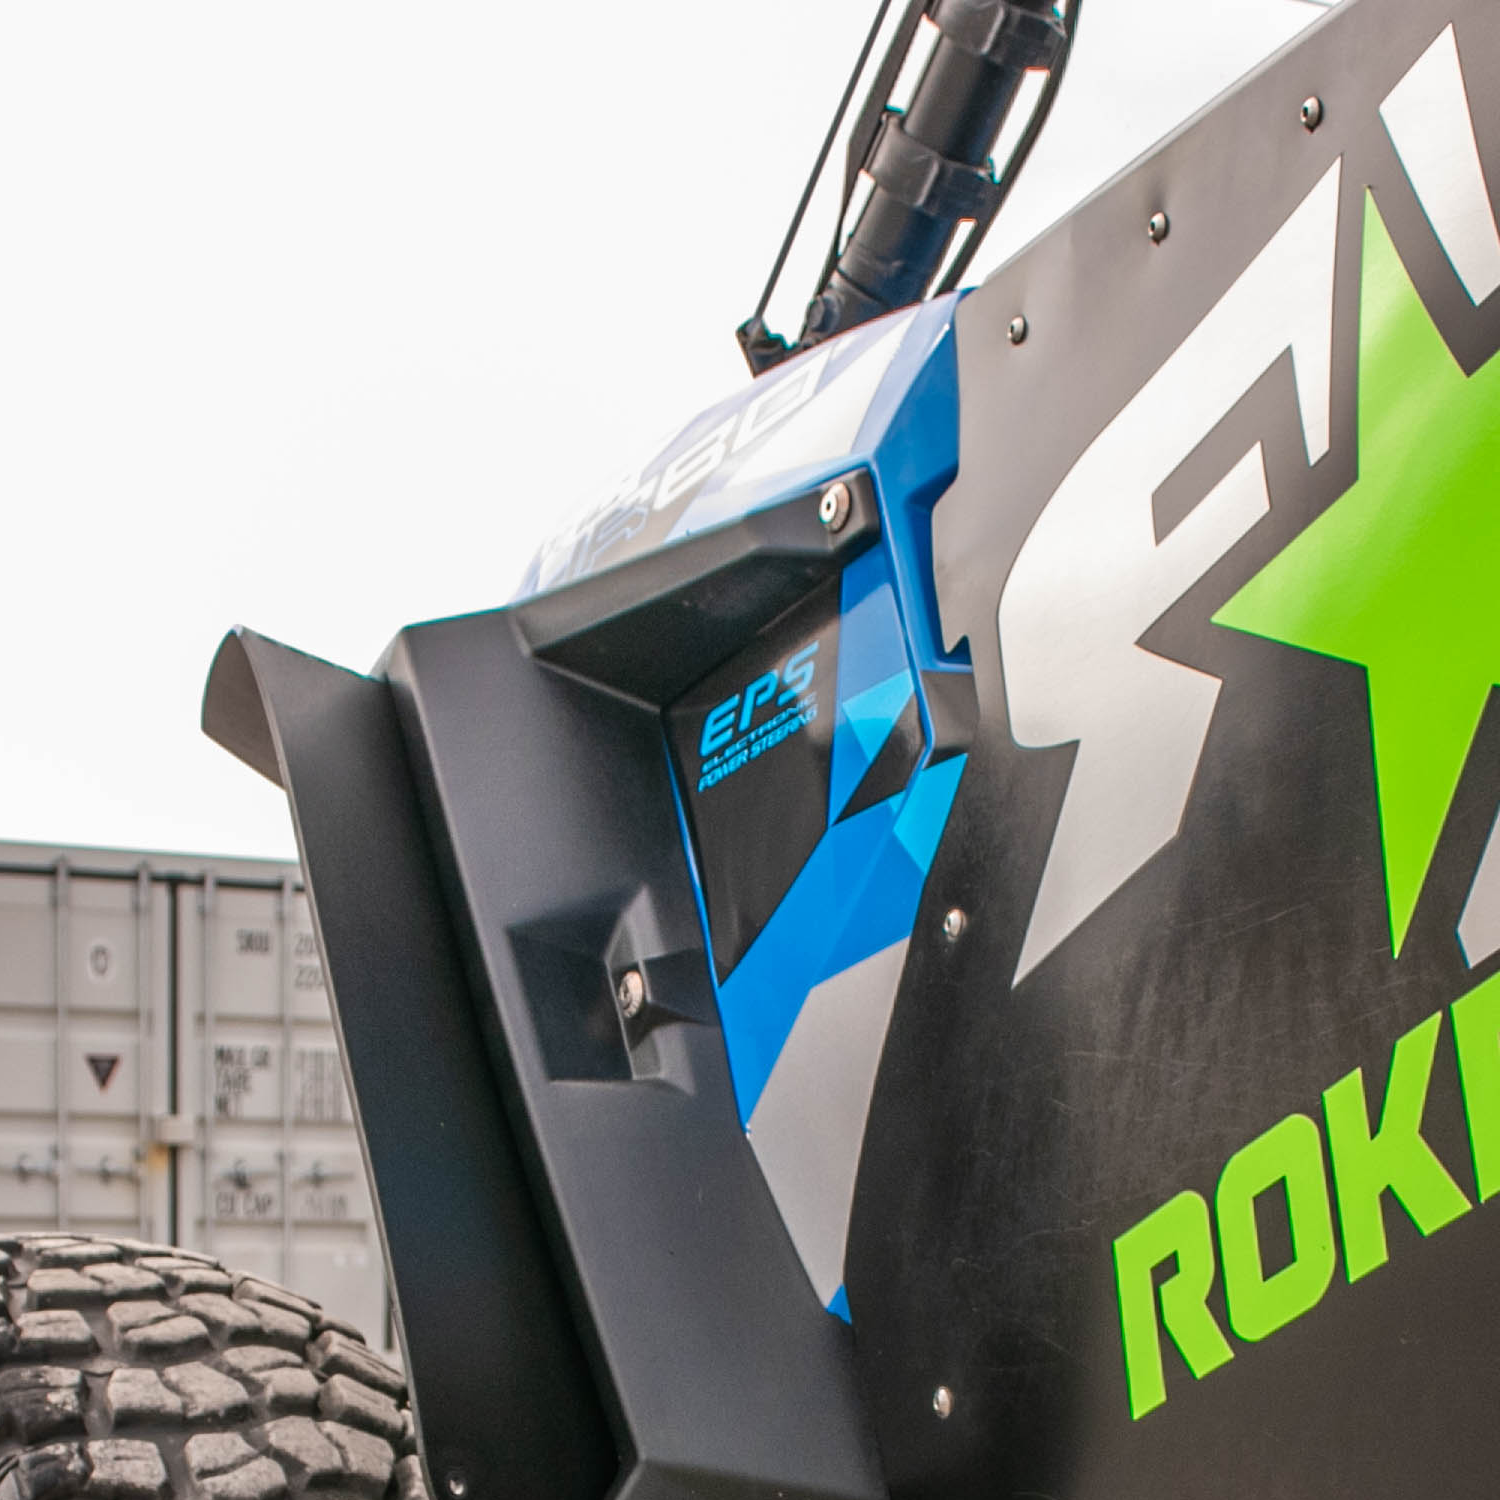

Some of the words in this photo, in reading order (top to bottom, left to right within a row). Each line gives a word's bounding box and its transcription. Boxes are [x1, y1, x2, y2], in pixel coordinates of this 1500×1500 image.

[699, 640, 820, 758] EPS
[700, 691, 818, 774] ELECTRONIC
[697, 748, 749, 793] POWER
[749, 703, 818, 760] STEERING
